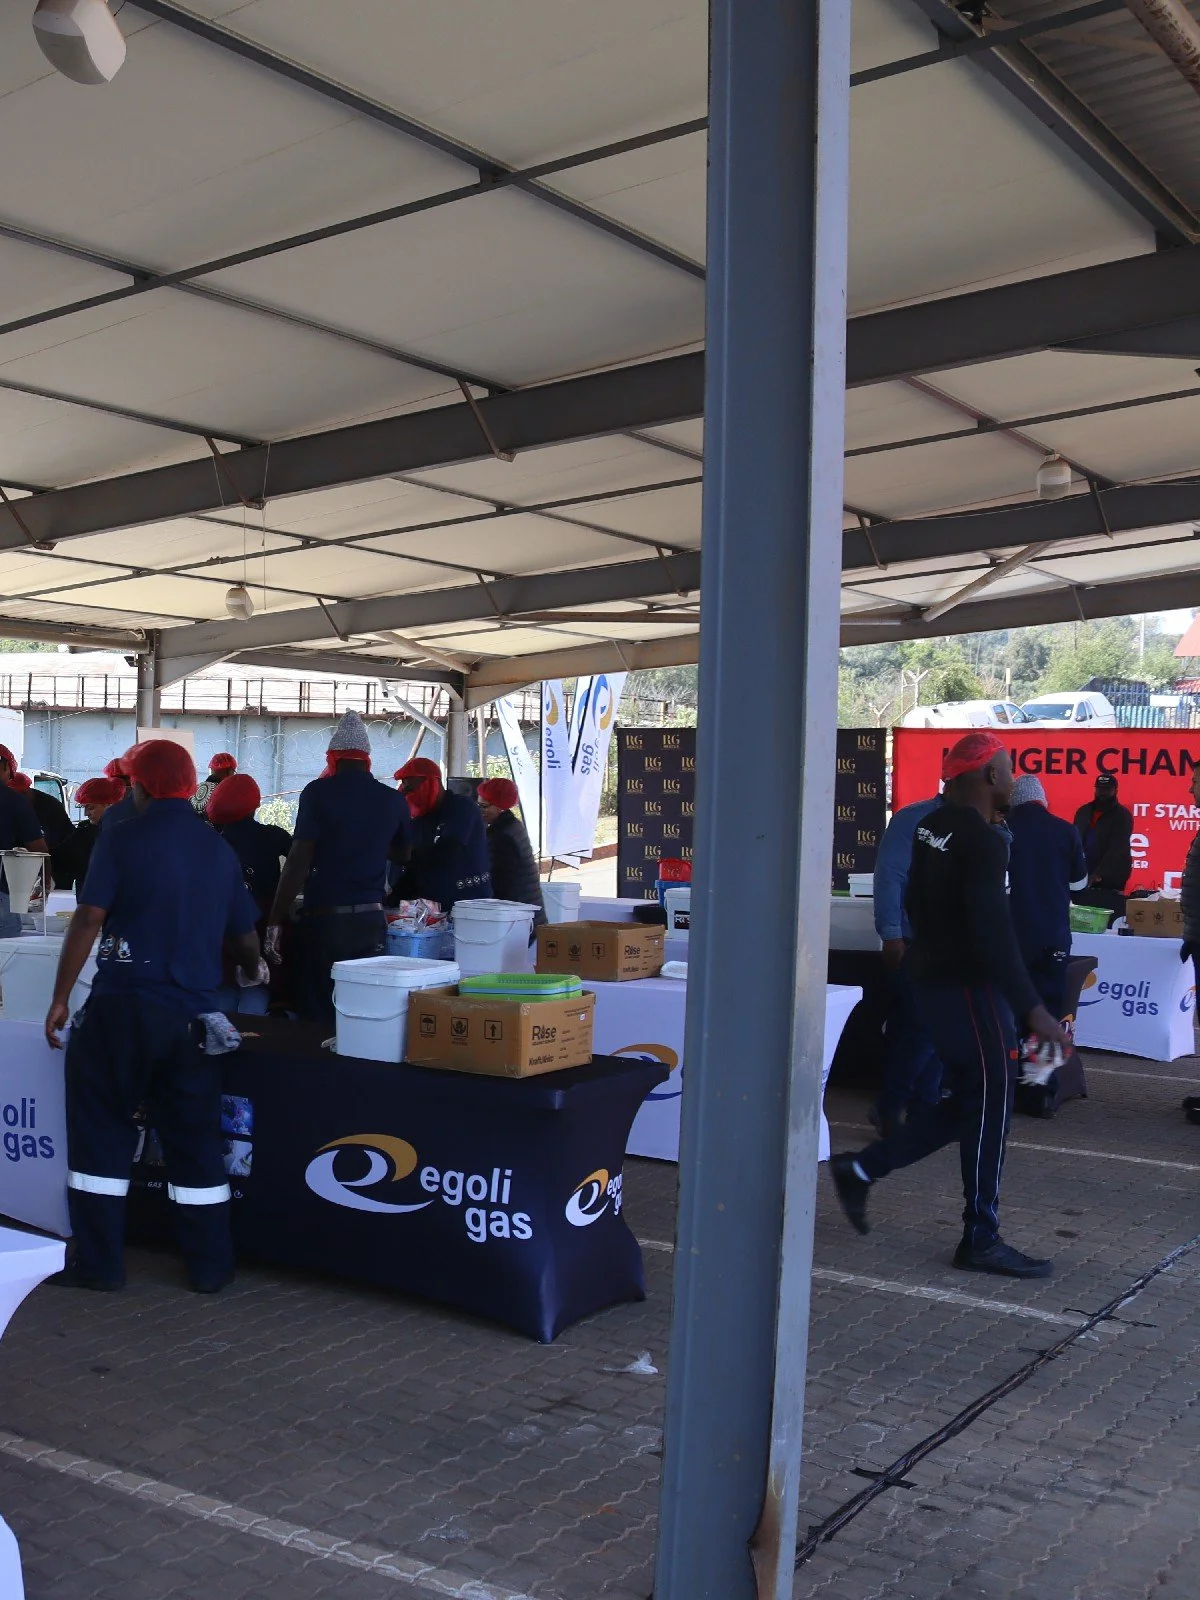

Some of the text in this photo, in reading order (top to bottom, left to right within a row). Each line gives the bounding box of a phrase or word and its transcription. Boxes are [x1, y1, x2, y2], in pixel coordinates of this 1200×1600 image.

[626, 734, 643, 745] RG
[663, 734, 680, 745] RG
[857, 735, 876, 746] RG
[581, 743, 594, 775] gas
[644, 756, 662, 768] RG
[837, 758, 856, 770] RG
[627, 778, 644, 790] RG
[663, 778, 680, 790] RG
[857, 782, 877, 794] RG
[644, 800, 662, 812] RG
[837, 805, 856, 817] RG
[1133, 804, 1151, 817] IT
[627, 822, 644, 834] RG
[663, 823, 680, 834] RG
[857, 829, 876, 841] RG
[644, 845, 662, 856] RG
[836, 853, 856, 865] RG
[626, 866, 643, 877] RG
[1098, 980, 1151, 1000] egoli
[1121, 999, 1159, 1017] gas
[3, 1131, 55, 1162] gas
[420, 1166, 513, 1206] egoli
[464, 1206, 533, 1243] gas
